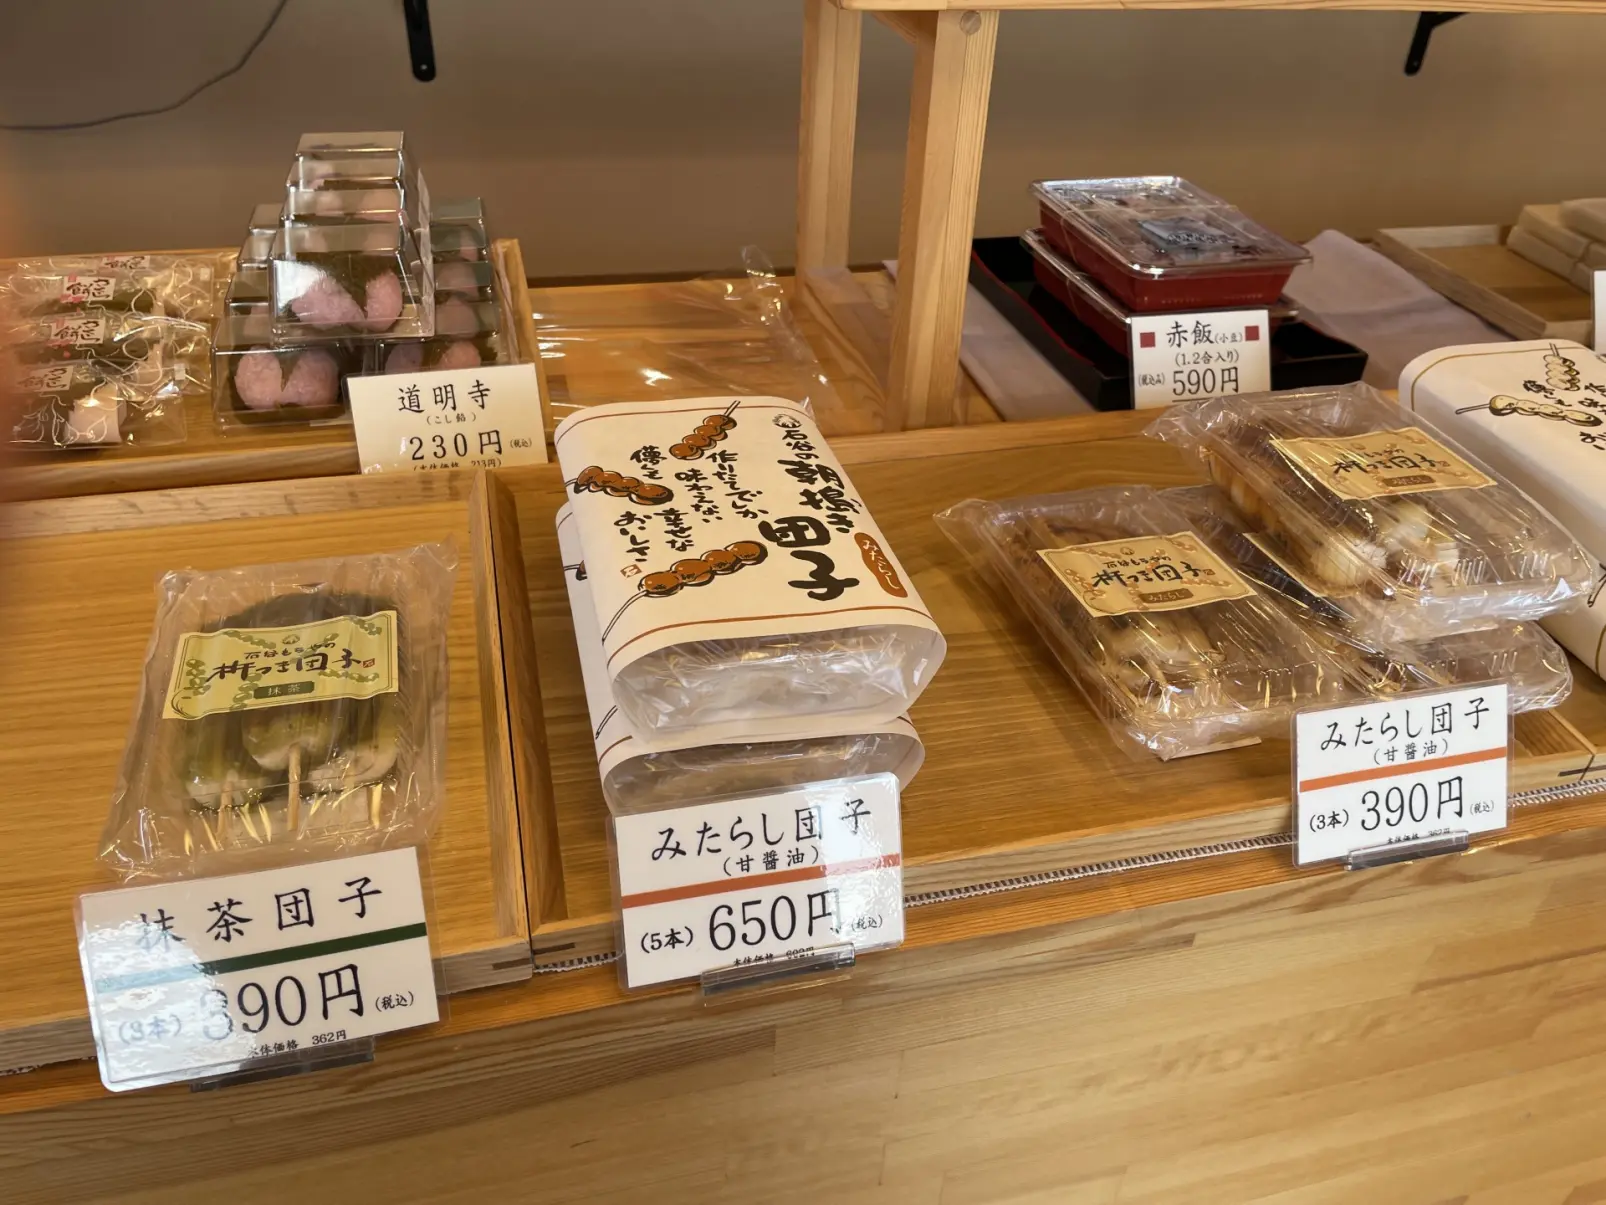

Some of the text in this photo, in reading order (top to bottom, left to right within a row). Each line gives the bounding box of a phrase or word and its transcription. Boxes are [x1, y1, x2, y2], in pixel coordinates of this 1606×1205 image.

[1166, 320, 1214, 349] 赤飯
[1175, 348, 1240, 367] (1.2合入り)
[397, 379, 492, 414] 道明寺
[1172, 366, 1239, 396] 590円
[409, 429, 533, 462] 230円 (税込)
[674, 468, 724, 524] 味わえない
[705, 449, 770, 519] 作りたてでしか
[613, 511, 653, 562] おいしさ
[653, 508, 695, 552] 幸せな
[758, 516, 860, 602] 団子
[862, 539, 900, 590] みたらし
[267, 685, 301, 697] 抹茶
[1320, 697, 1490, 751] みたらし団子
[1373, 738, 1449, 765] (甘醤油)
[1309, 775, 1495, 832] (3本) 390円 (税込)
[651, 798, 872, 862] みたらし団子
[723, 845, 820, 877] (甘醤油)
[640, 887, 884, 953] (5本) 650円 (税込)
[199, 963, 366, 1042] 390円
[374, 991, 415, 1012] (税込)
[311, 1029, 347, 1045] 362円
